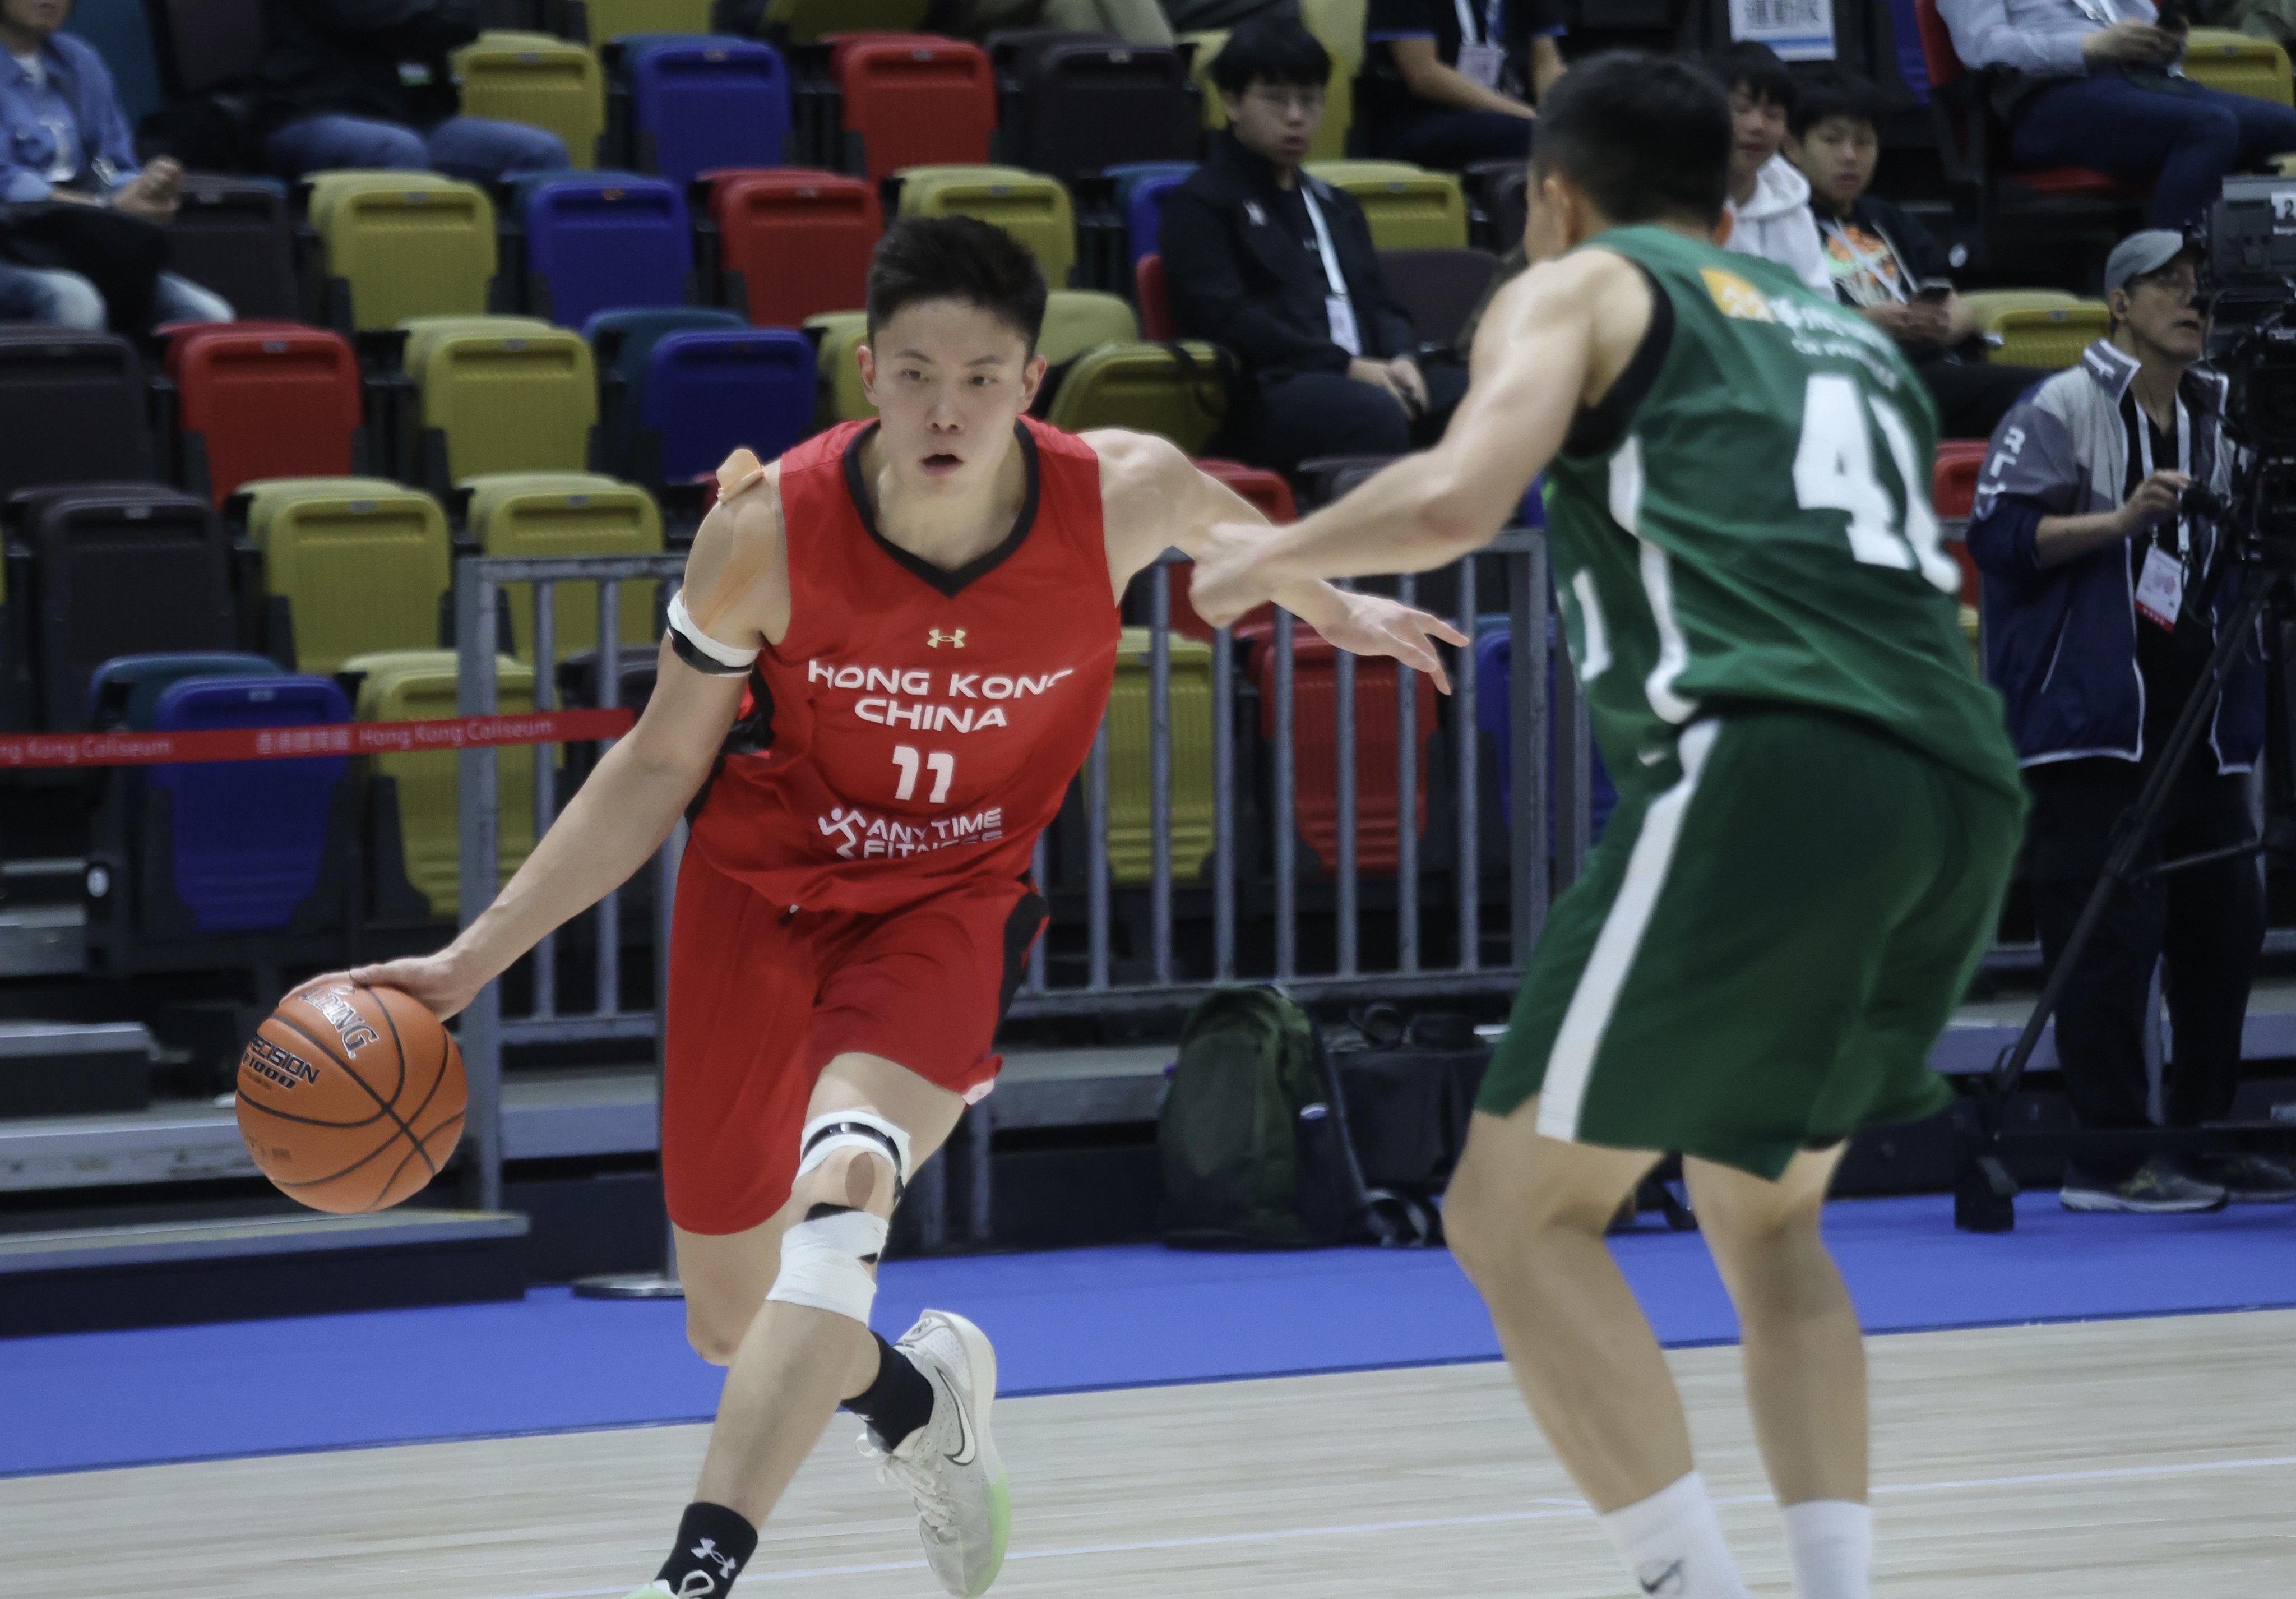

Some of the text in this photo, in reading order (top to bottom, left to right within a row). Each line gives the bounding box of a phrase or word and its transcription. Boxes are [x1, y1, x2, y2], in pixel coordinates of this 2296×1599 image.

[808, 660, 929, 695] HONG
[854, 699, 1007, 733] CHINA
[892, 745, 954, 803] 11
